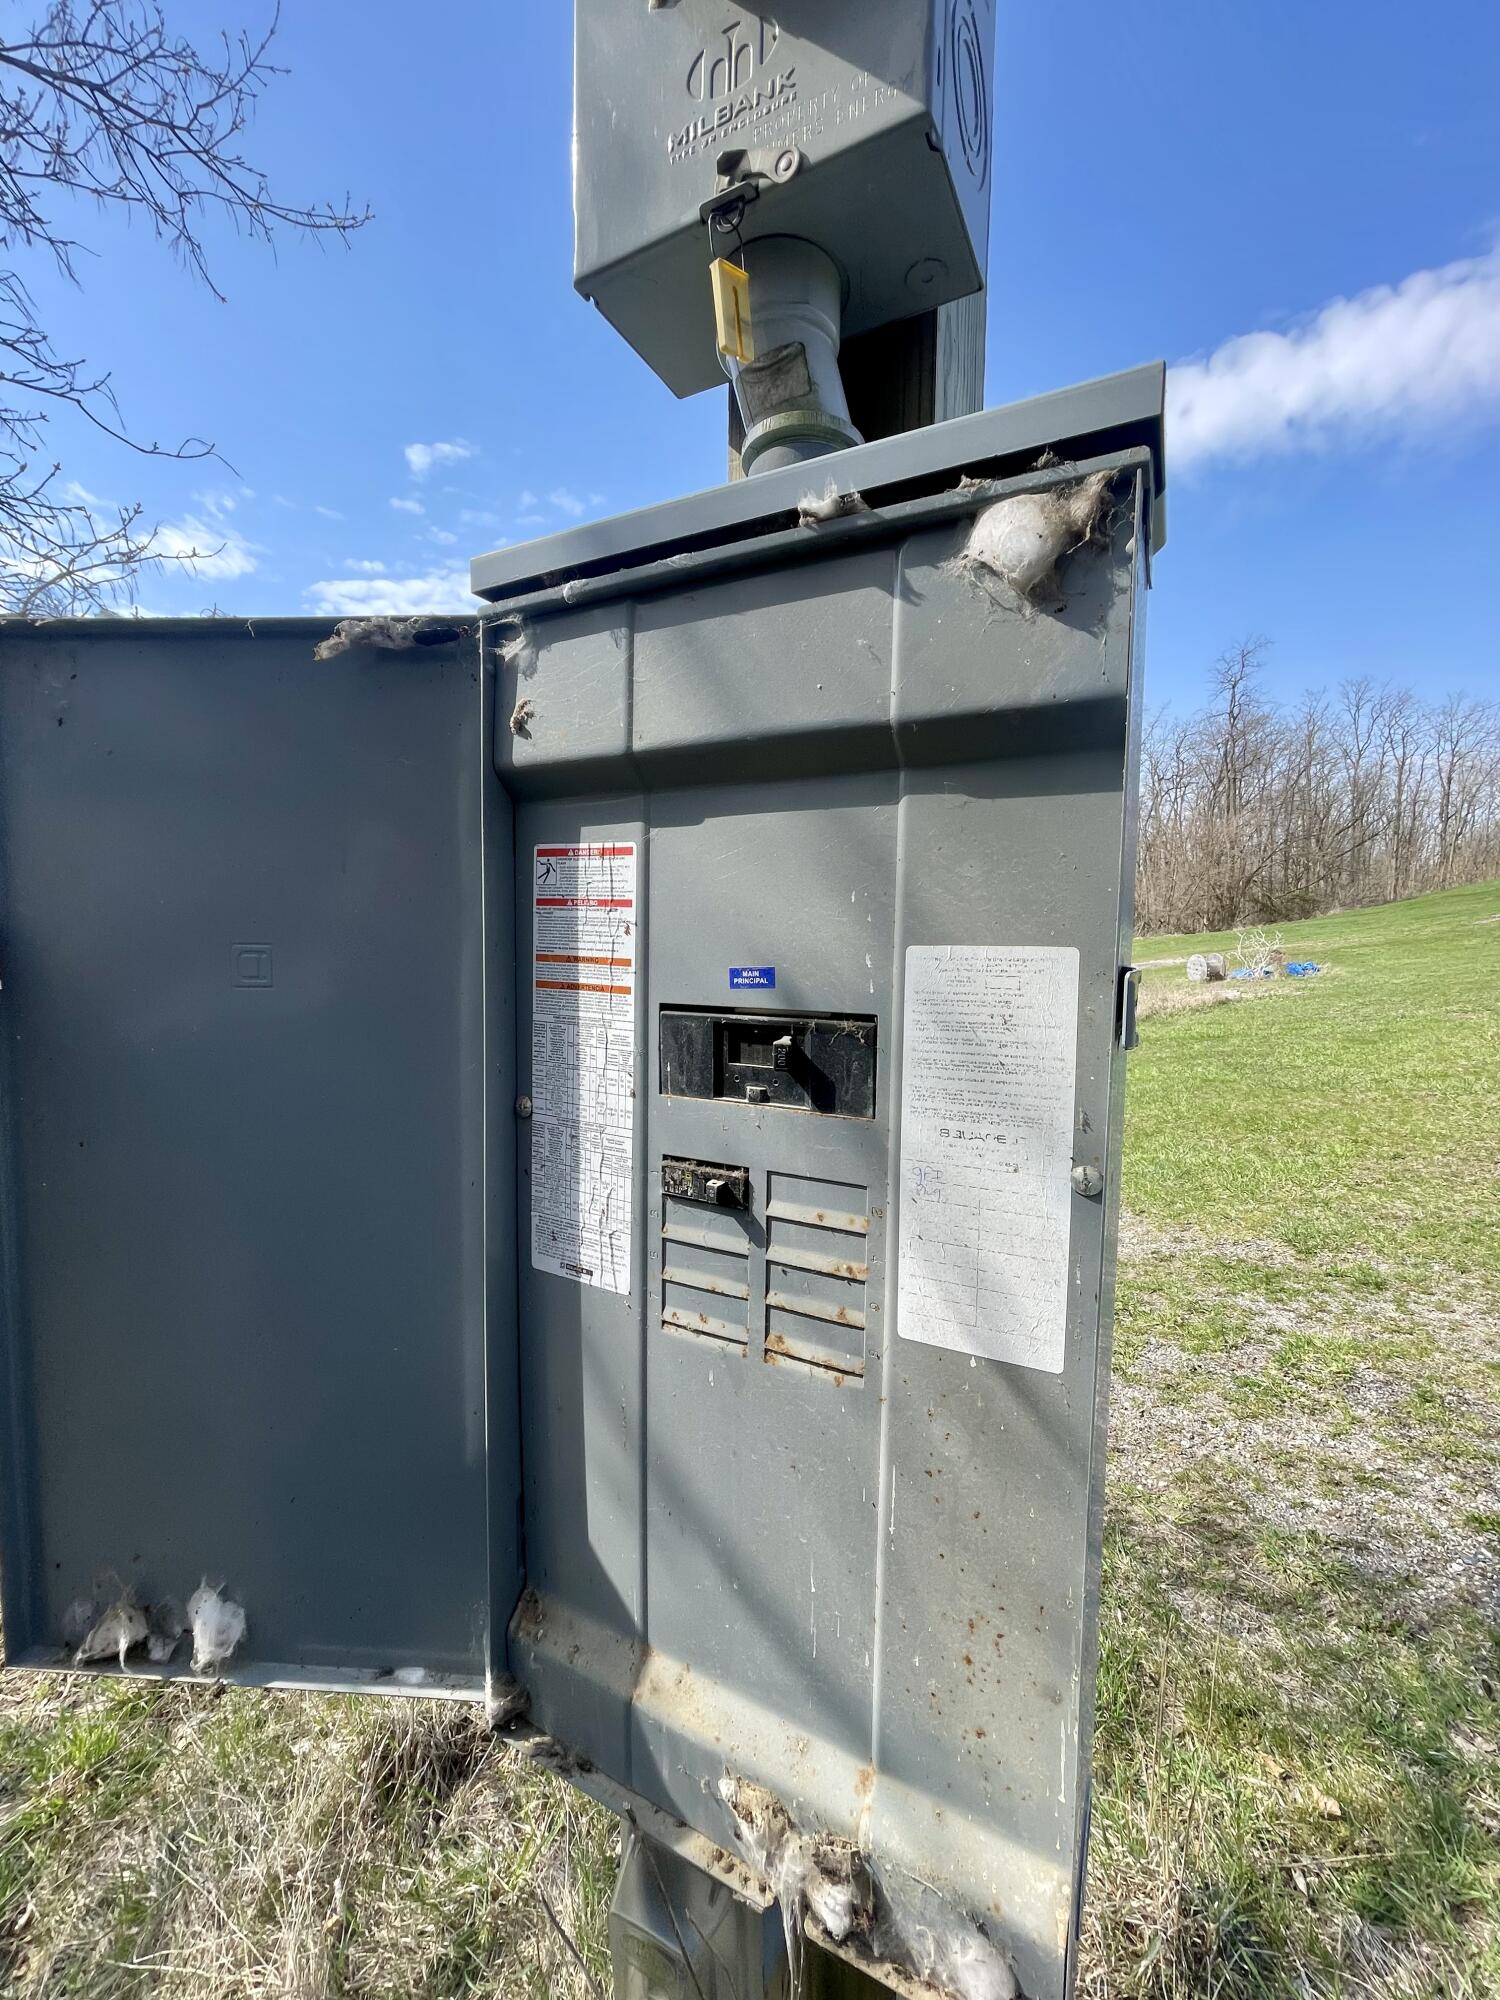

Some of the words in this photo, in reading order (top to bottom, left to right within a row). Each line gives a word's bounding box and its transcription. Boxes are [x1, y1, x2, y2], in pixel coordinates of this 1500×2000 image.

[668, 66, 797, 154] MILBANK
[733, 977, 769, 985] PRINCIPAL
[777, 1047, 787, 1066] 200
